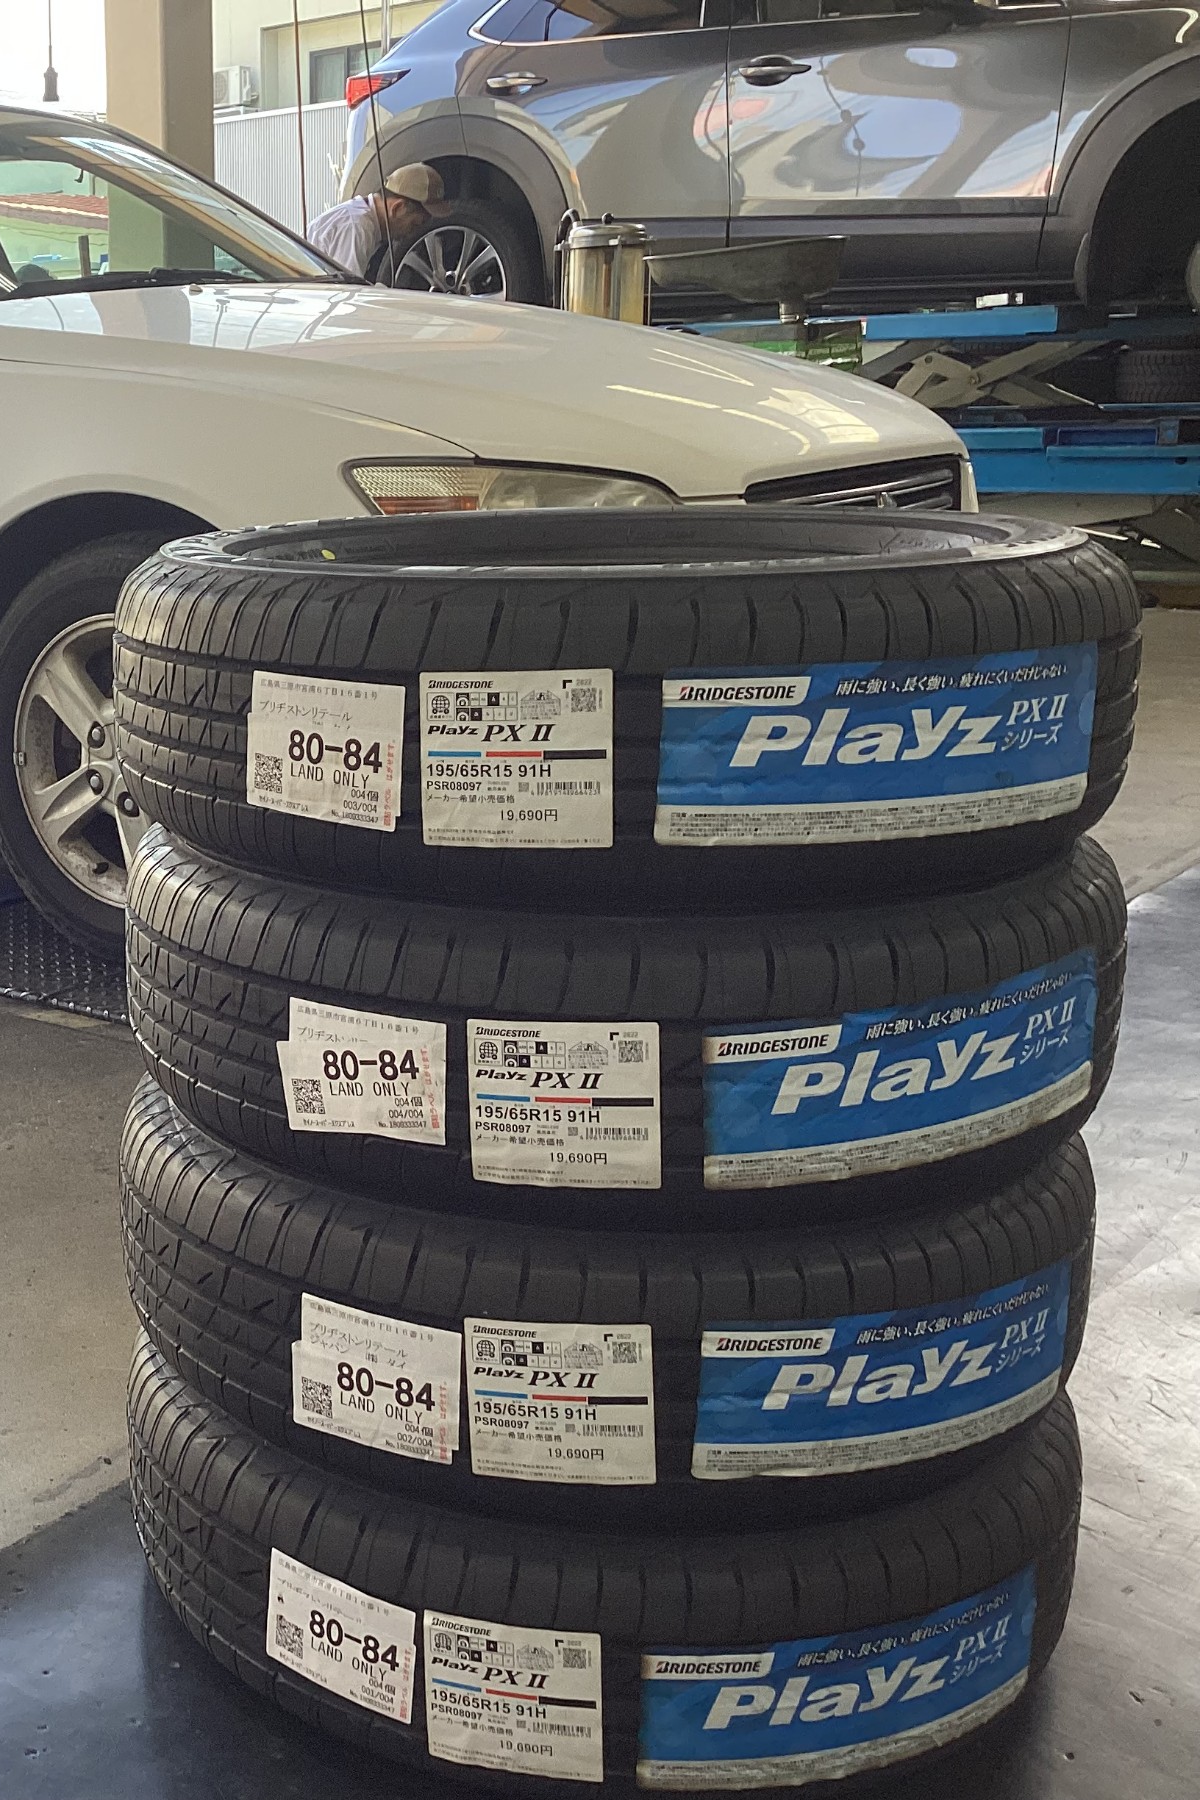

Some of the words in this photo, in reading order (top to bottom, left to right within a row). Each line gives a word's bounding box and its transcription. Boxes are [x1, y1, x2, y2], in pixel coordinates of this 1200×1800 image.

[428, 680, 494, 689] BRIDGESTONE
[679, 684, 797, 702] BRIDGESTONE
[260, 701, 353, 721] ブリヂストンリテール
[1006, 697, 1048, 726] PX
[481, 724, 526, 742] PX
[1001, 722, 1064, 751] シリーズ
[288, 729, 382, 773] 80-84
[290, 762, 323, 782] LAND
[334, 769, 369, 789] ONLY
[426, 763, 513, 778] 195/65R15
[518, 764, 551, 777] 91H
[351, 788, 378, 801] 004個
[426, 781, 482, 791] PSR08097
[343, 800, 377, 813] 003/004
[426, 794, 515, 804] メーカー希望小売価格
[501, 809, 558, 822] 19,690円
[1023, 1004, 1059, 1041] PX
[475, 1026, 541, 1038] BRIDGESTONE
[717, 1034, 829, 1057] BRIDGESTONE
[1019, 1027, 1071, 1065] シリーズ
[323, 1049, 419, 1081] 80-84
[329, 1081, 363, 1097] LAND
[373, 1081, 409, 1097] ONLY
[530, 1071, 575, 1089] PX
[395, 1096, 423, 1107] 004個
[389, 1109, 424, 1119] 004/004
[475, 1105, 562, 1123] 195/65R15
[567, 1110, 600, 1124] 91H
[475, 1121, 532, 1134] PSR08097
[475, 1134, 565, 1147] メーカー希望小売価格
[550, 1151, 608, 1165] 19,690円
[309, 1321, 408, 1358] ブリヂストンリテール
[473, 1325, 537, 1338] BRIDGESTONE
[999, 1317, 1034, 1349] PX
[716, 1337, 823, 1352] BRIDGESTONE
[995, 1333, 1046, 1373] シリーズ
[337, 1362, 436, 1412] 80-84
[528, 1370, 571, 1388] PX
[340, 1391, 375, 1413] LAND
[385, 1404, 423, 1425] ONLY
[474, 1401, 559, 1419] 195/65R15
[564, 1407, 597, 1421] 91H
[405, 1424, 434, 1438] 004個
[474, 1415, 530, 1430] PSR08097
[397, 1432, 433, 1448] 002/004
[475, 1429, 562, 1443] メーカー希望小売価格
[548, 1447, 604, 1461] 19,690円
[432, 1617, 492, 1636] BRIDGESTONE
[309, 1609, 399, 1672] 80-84
[953, 1625, 991, 1662] PX
[311, 1637, 343, 1663] LAND
[351, 1656, 387, 1682] ONLY
[655, 1660, 761, 1675] BRIDGESTONE
[950, 1640, 1008, 1685] シリーズ
[482, 1666, 524, 1686] PX
[361, 1684, 394, 1705] 001/004
[431, 1689, 511, 1714] 195/65R15
[516, 1705, 547, 1719] 91H
[431, 1702, 482, 1721] PSR08097
